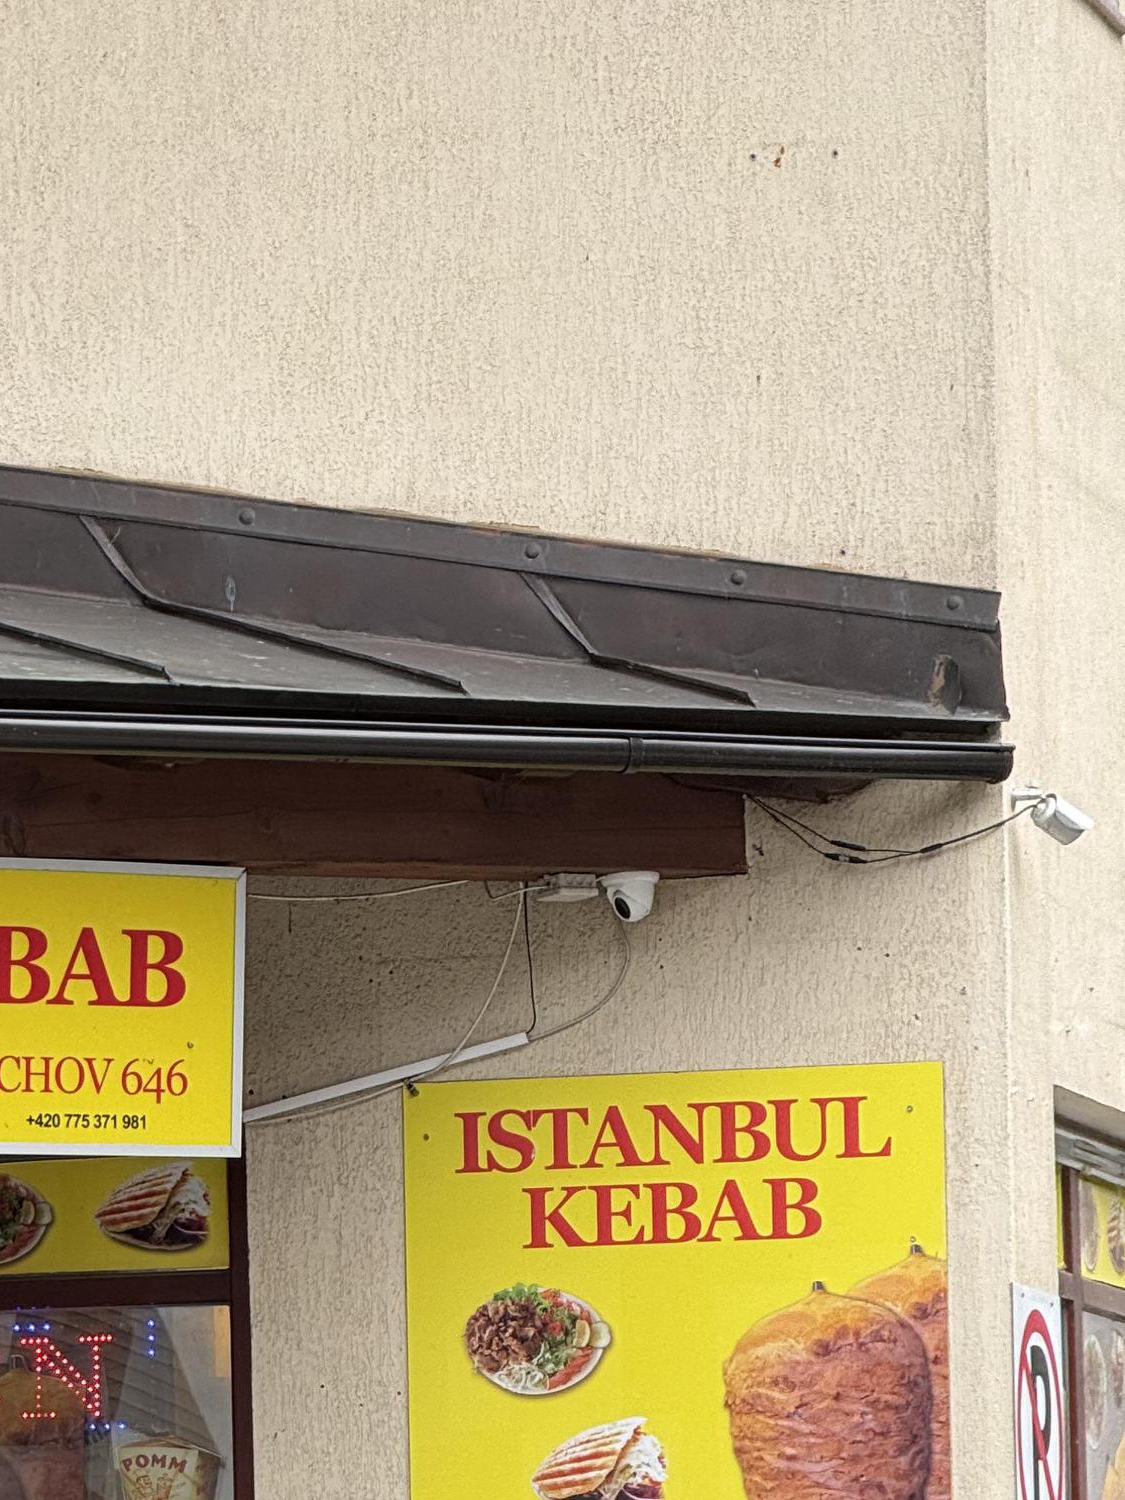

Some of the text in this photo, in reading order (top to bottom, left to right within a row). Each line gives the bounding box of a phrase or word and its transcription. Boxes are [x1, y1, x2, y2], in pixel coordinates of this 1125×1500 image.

[121, 1057, 189, 1104] 646
[26, 1113, 147, 1130] +420 775 371 981
[454, 1096, 893, 1174] ISTANBUL
[522, 1177, 823, 1249] KEBAB
[122, 1453, 187, 1474] POMM
